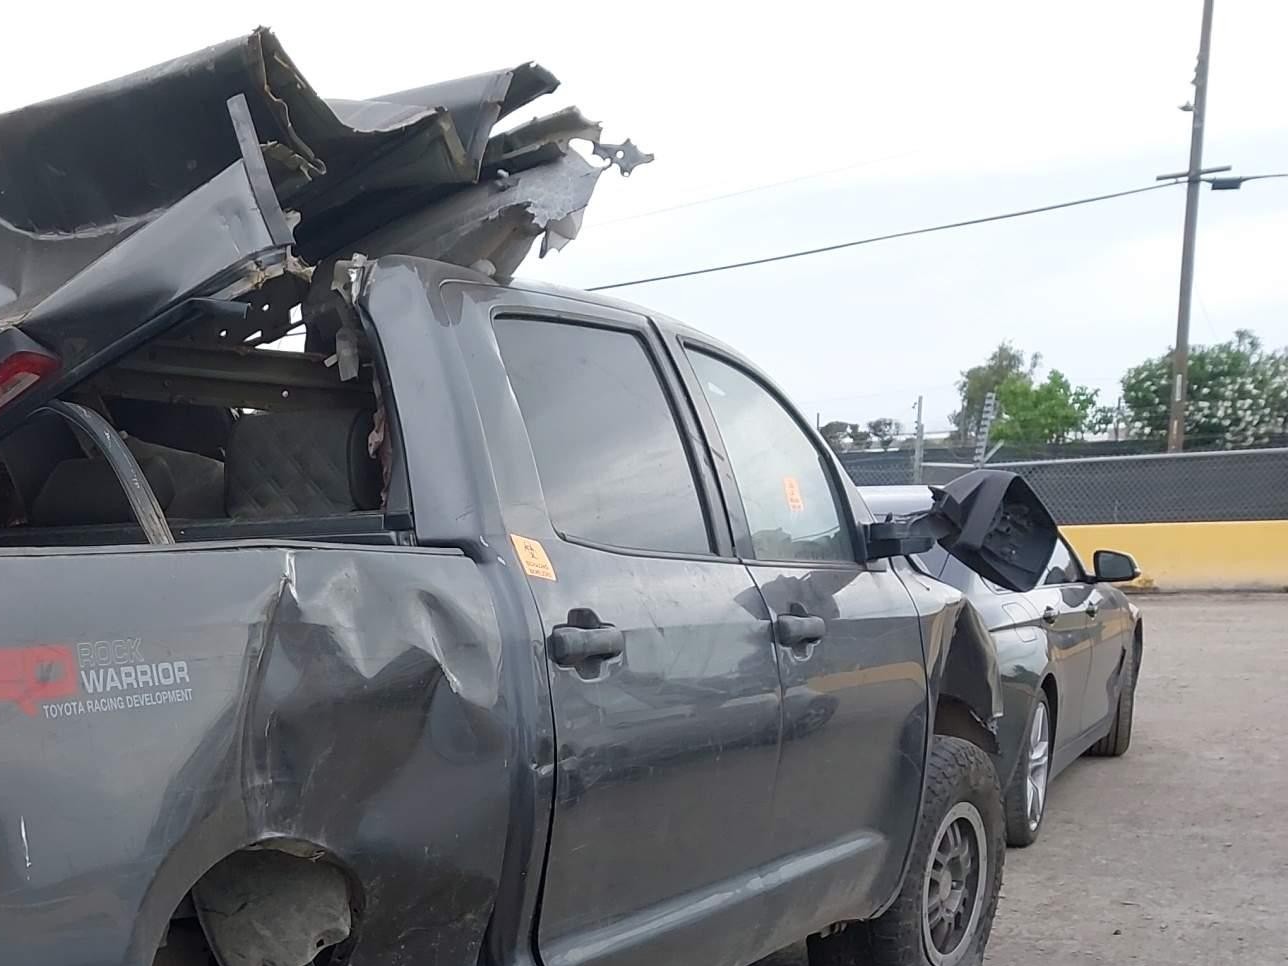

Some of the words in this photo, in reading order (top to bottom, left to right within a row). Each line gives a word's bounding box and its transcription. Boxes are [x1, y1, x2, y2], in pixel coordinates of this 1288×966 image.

[76, 637, 145, 669] ROCK
[80, 660, 191, 694] WARRIOR
[42, 700, 86, 719] TOYOTA
[86, 696, 126, 713] RACING
[125, 688, 193, 708] DEVELOPMENT
